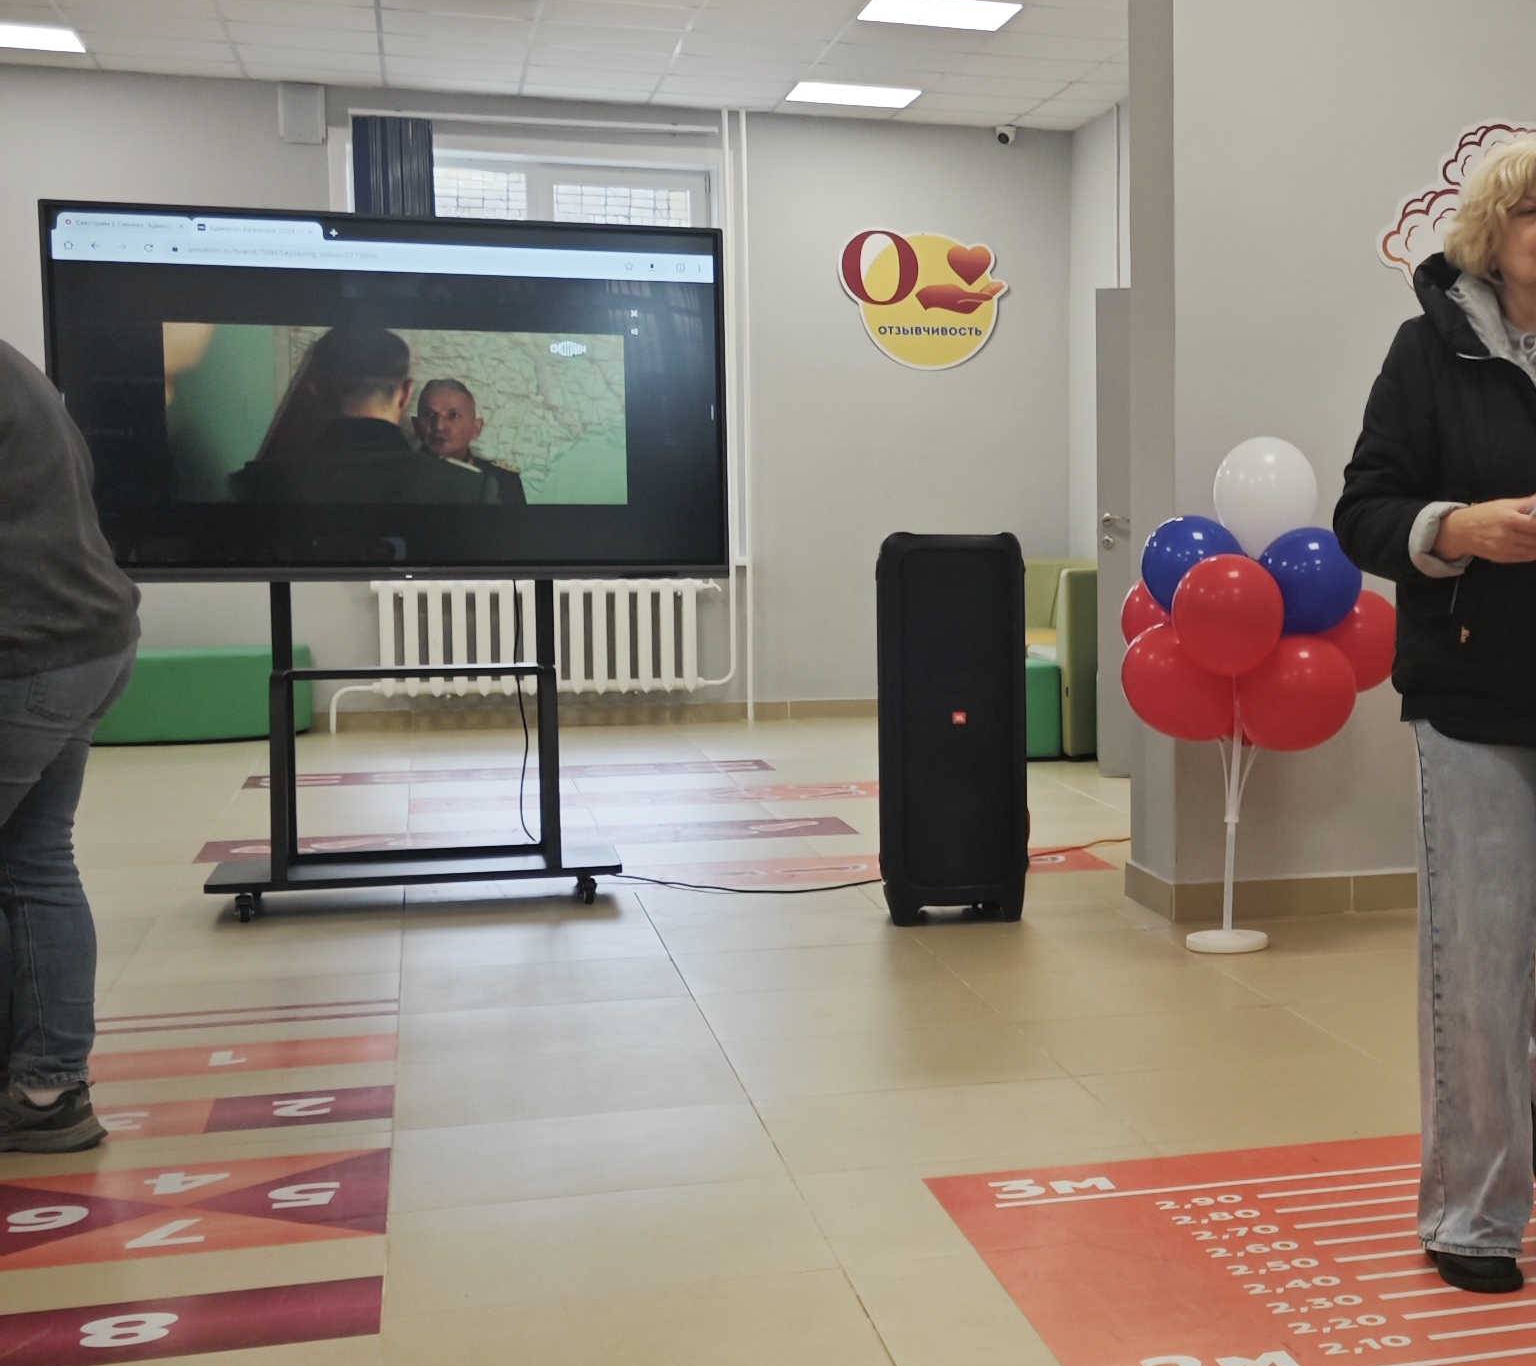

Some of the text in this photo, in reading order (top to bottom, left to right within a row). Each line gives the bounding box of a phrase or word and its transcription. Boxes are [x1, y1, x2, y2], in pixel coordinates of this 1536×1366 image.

[878, 325, 982, 337] ОТЗЫВЧИВОСТЬ
[209, 1050, 247, 1067] 1
[273, 1095, 337, 1118] 2
[143, 1171, 230, 1196] 4
[267, 1180, 342, 1210] 5
[1155, 1193, 1243, 1211] 2,90
[1170, 1208, 1261, 1226] 2,80
[125, 1218, 206, 1249] 7
[1191, 1224, 1280, 1241] 2,70
[1205, 1240, 1300, 1259] 2,60
[1227, 1257, 1320, 1276] 2,50
[1243, 1275, 1342, 1295] 2,40
[1266, 1294, 1364, 1315] 2,30
[79, 1311, 180, 1348] 8
[1288, 1313, 1388, 1335] 2,20
[1318, 1334, 1413, 1356] 2,10
